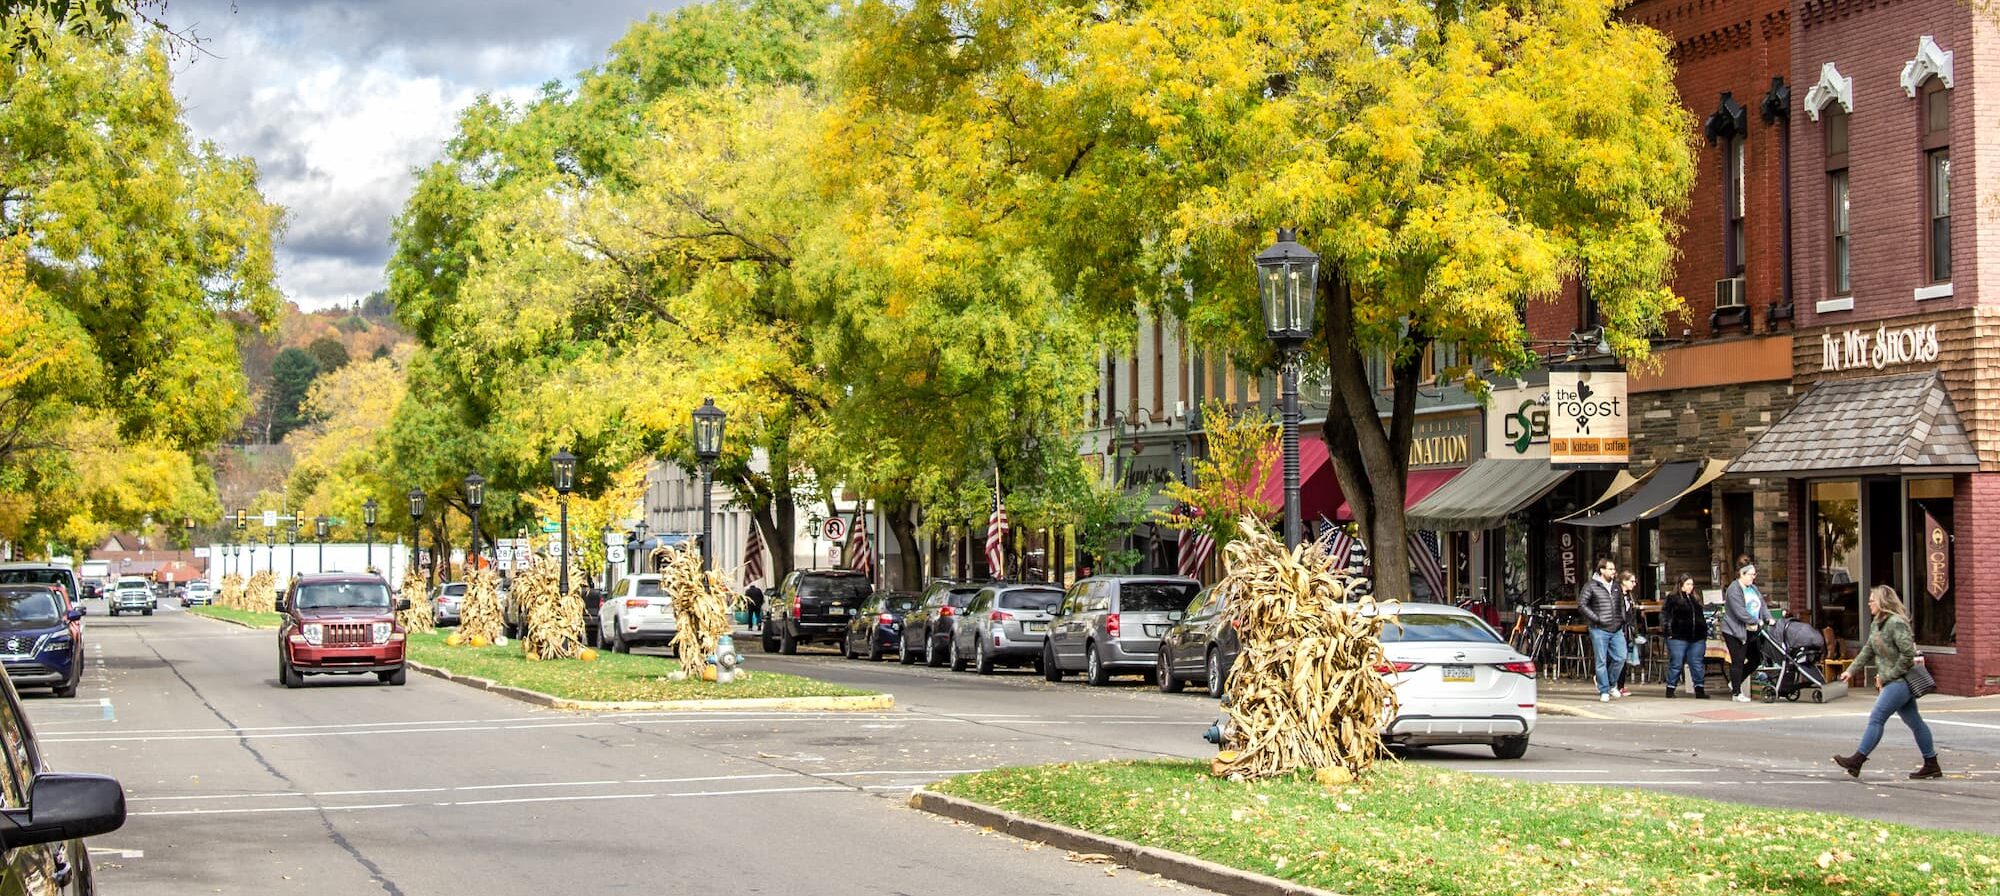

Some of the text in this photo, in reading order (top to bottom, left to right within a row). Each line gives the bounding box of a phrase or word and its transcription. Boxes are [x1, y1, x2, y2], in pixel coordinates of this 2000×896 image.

[1821, 323, 1939, 372] IN MY SHOES
[1556, 389, 1578, 400] the
[1557, 396, 1621, 417] roost
[1553, 440, 1626, 453] pub kitchen coffee
[498, 549, 512, 558] 287
[553, 544, 560, 553] 6
[612, 549, 620, 559] 6
[1930, 552, 1946, 594] OPEN
